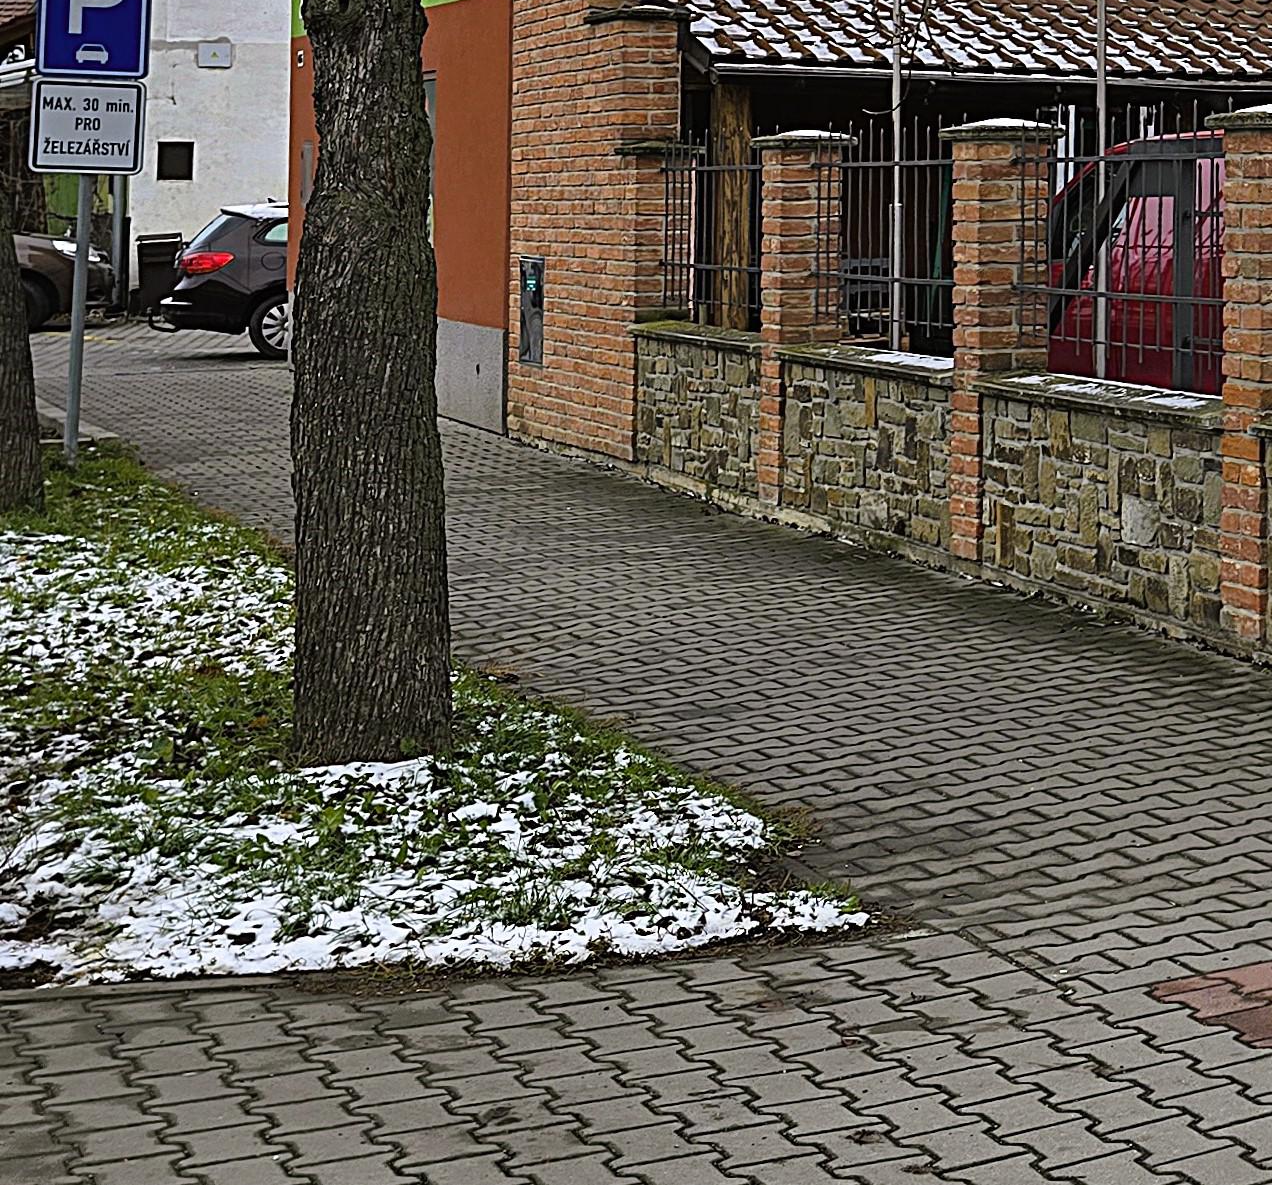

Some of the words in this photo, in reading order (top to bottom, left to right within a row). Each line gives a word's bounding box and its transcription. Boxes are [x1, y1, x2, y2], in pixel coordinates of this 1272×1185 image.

[43, 96, 76, 112] MAX.
[83, 97, 99, 112] 30
[106, 99, 134, 113] min.
[75, 117, 101, 131] PRO
[43, 137, 130, 156] ŽELEZÁŘSTVÍ
